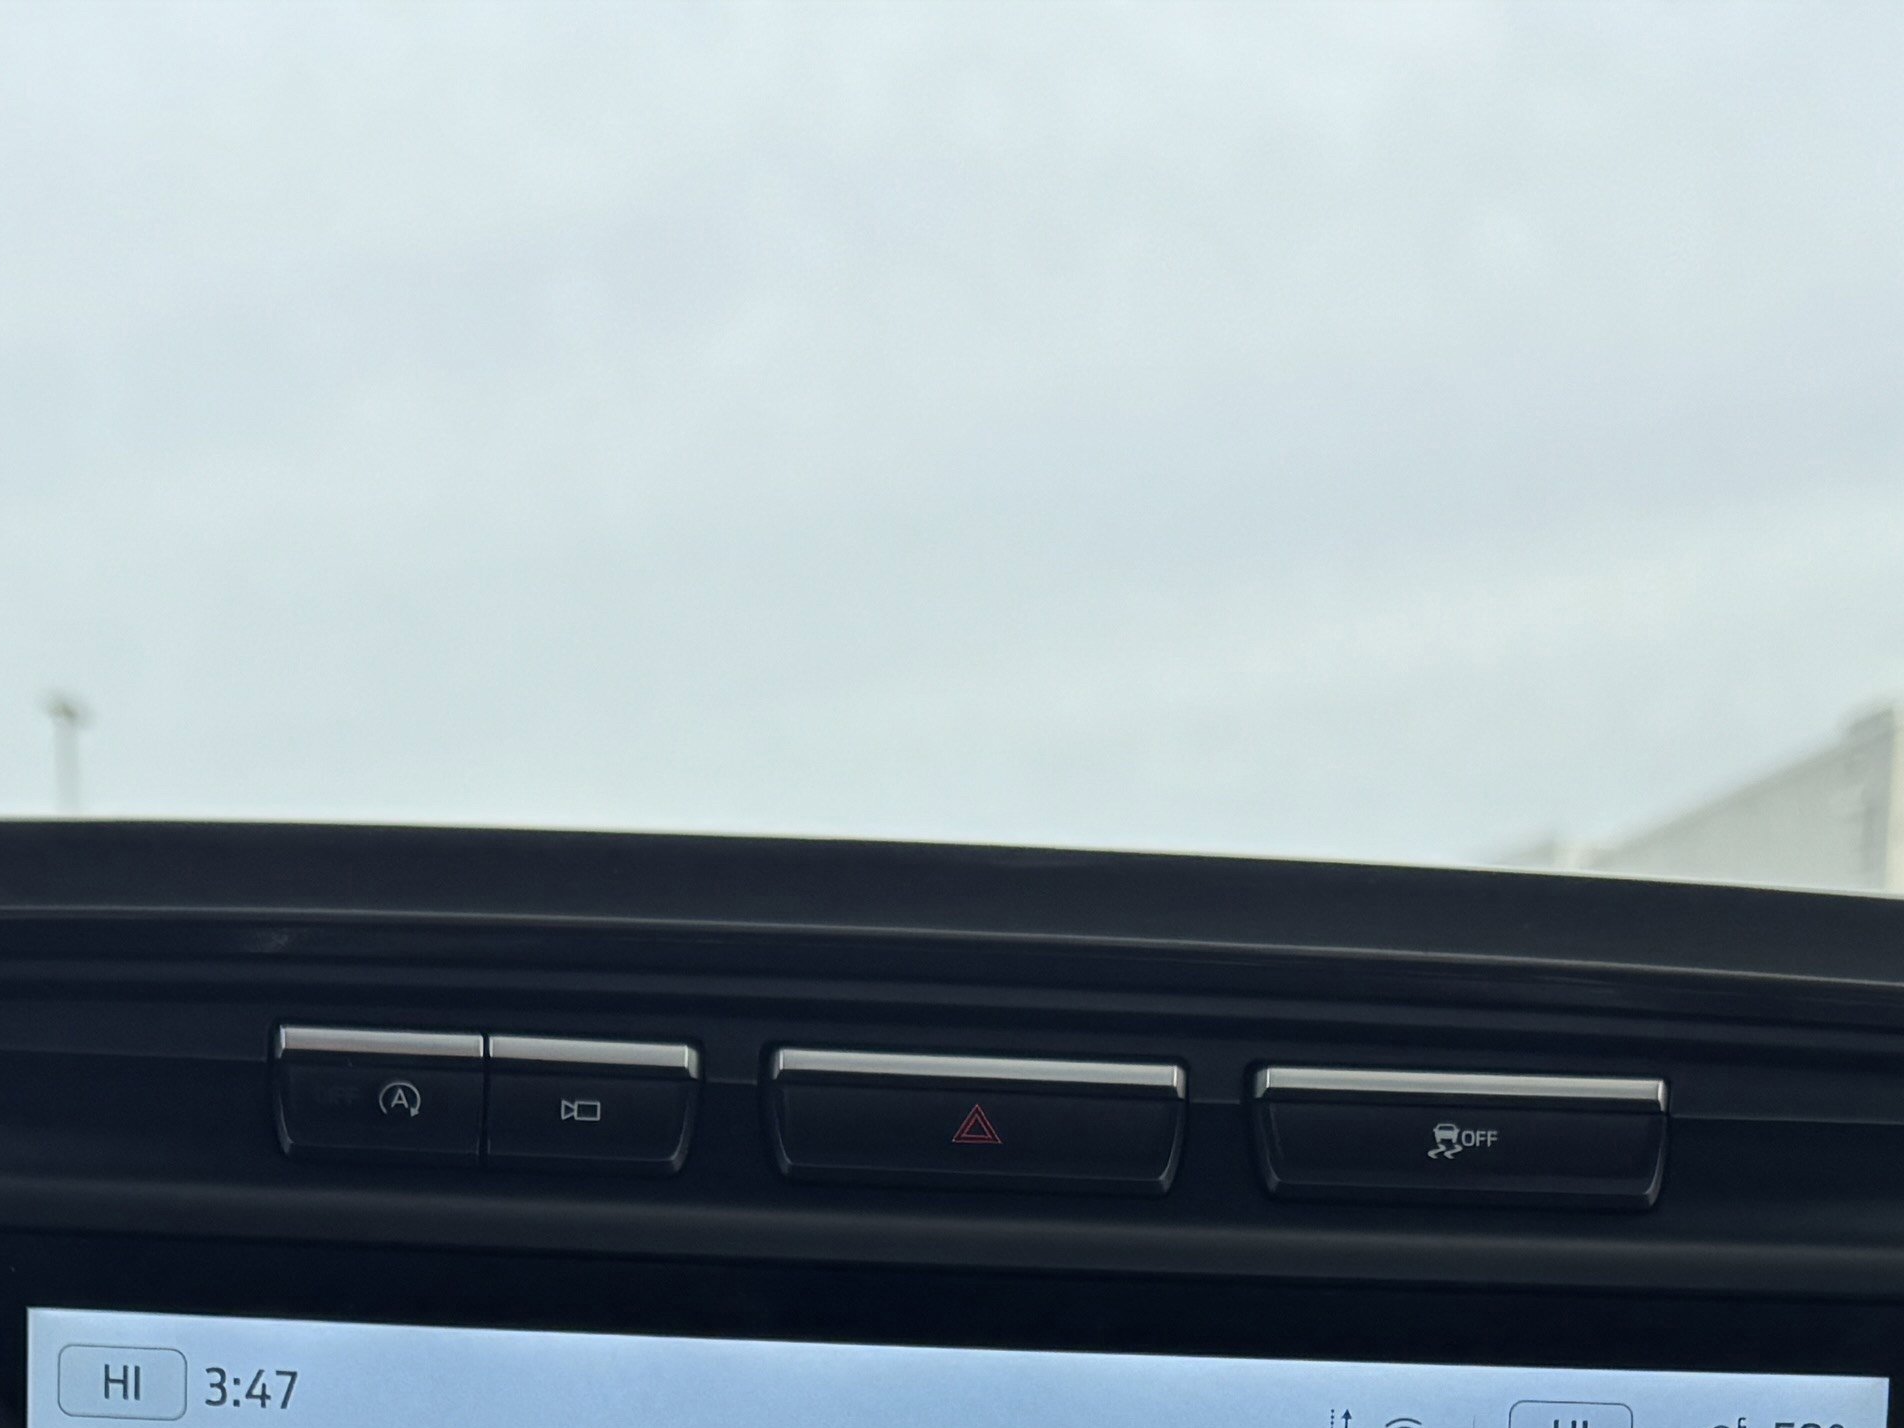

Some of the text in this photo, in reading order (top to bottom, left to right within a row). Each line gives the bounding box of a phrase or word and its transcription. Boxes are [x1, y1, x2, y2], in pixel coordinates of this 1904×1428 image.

[1462, 1130, 1498, 1147] OFF
[105, 1364, 140, 1400] HI
[205, 1367, 297, 1409] 3:47
